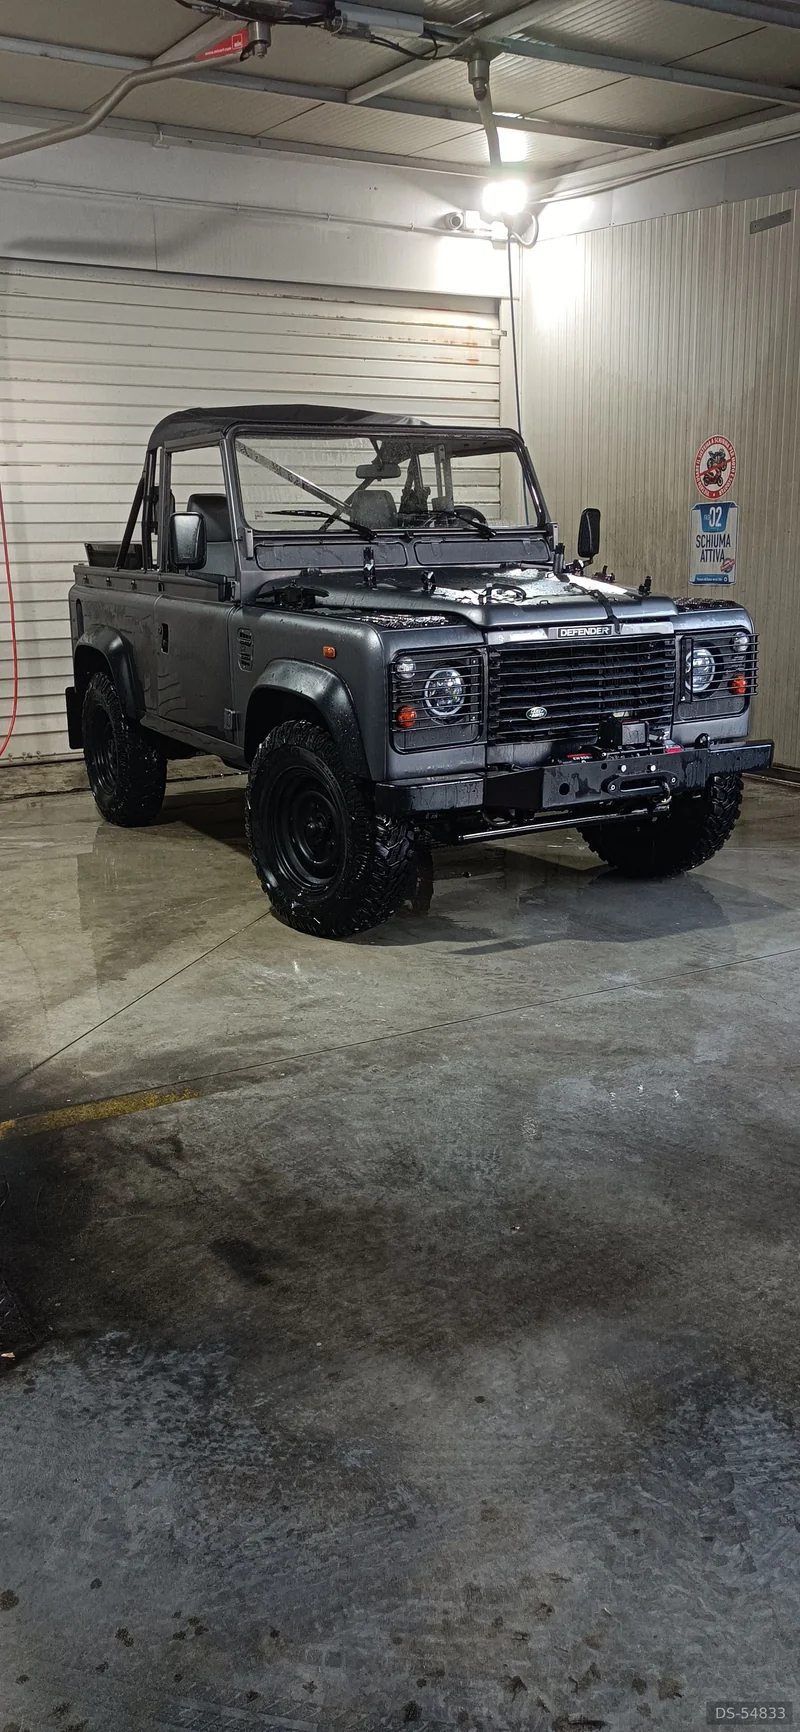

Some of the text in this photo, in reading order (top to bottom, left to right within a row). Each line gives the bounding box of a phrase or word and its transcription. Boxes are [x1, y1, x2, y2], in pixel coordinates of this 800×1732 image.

[709, 506, 722, 527] 02
[696, 534, 731, 548] SCHIUMA
[700, 549, 724, 562] ATTIVA
[560, 627, 609, 636] DEFENDER
